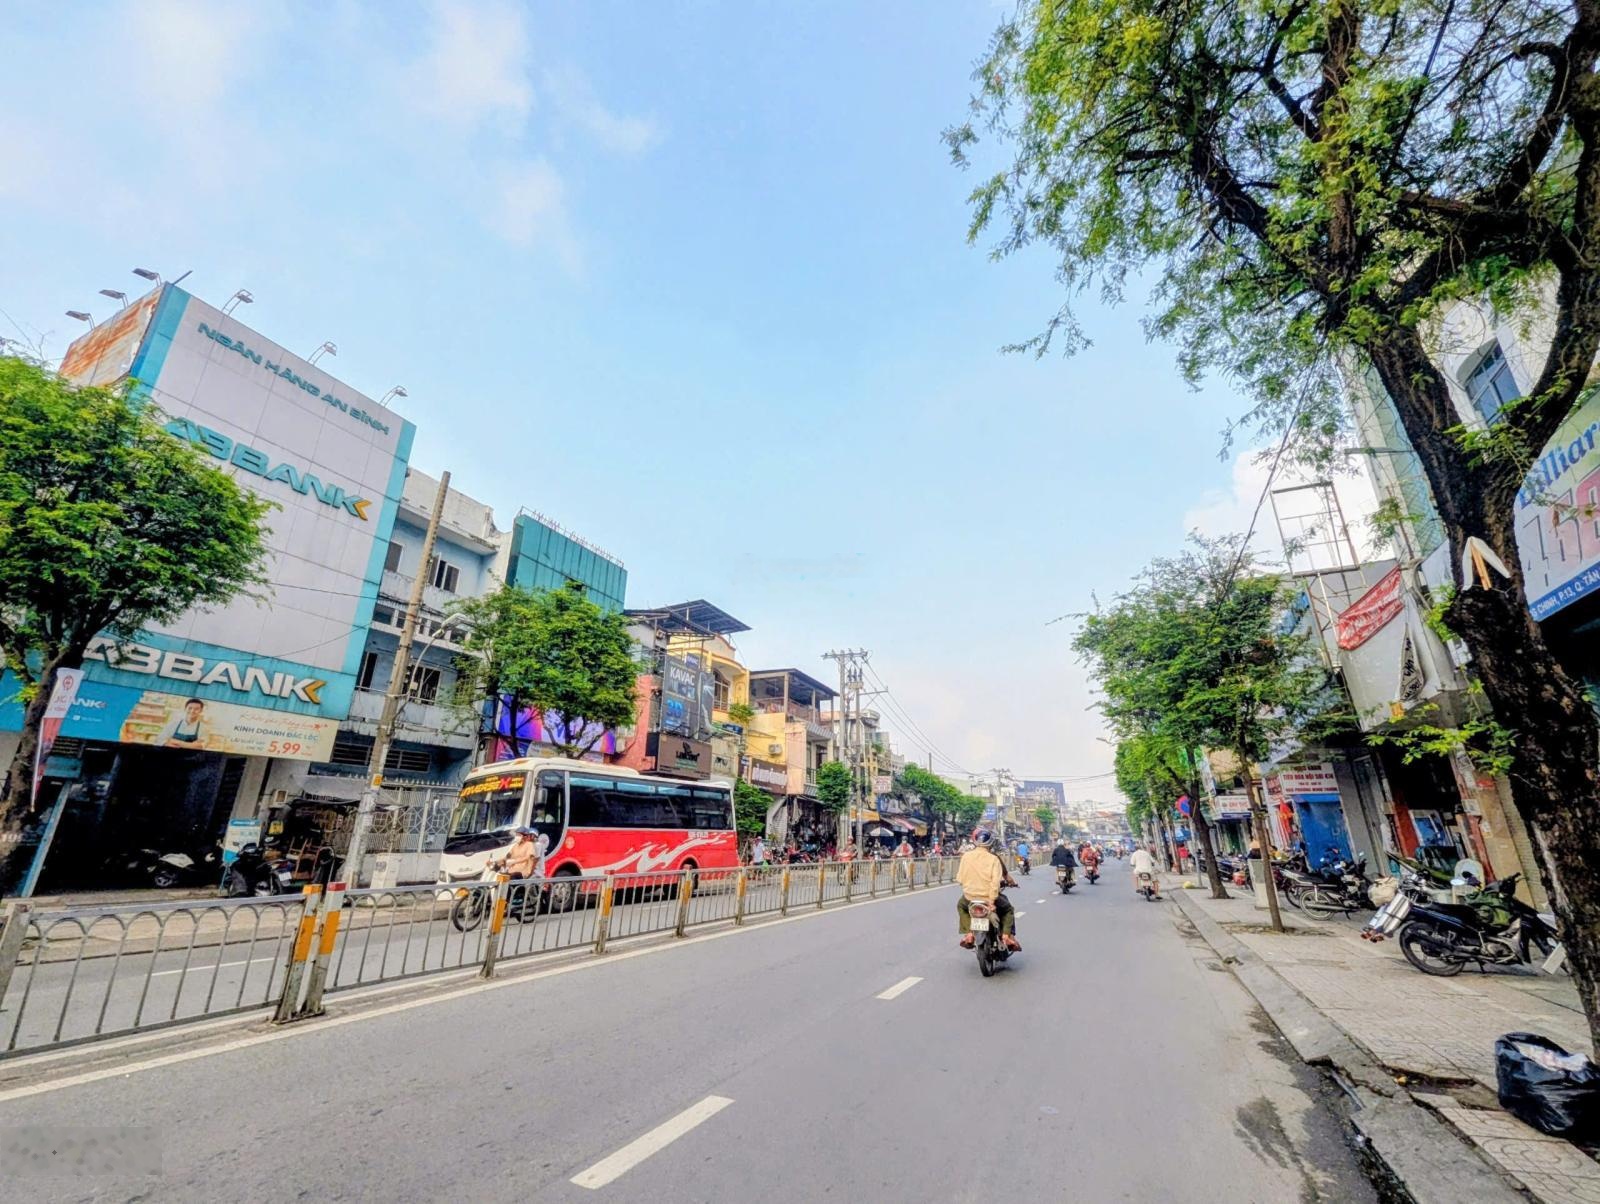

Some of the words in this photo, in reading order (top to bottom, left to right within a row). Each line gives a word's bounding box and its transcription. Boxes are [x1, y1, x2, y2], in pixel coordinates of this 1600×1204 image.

[198, 322, 263, 365] NGÂN
[321, 394, 348, 413] AN
[165, 416, 372, 521] ABBANK
[82, 636, 327, 705] ABBANK
[268, 740, 301, 755] 5,99
